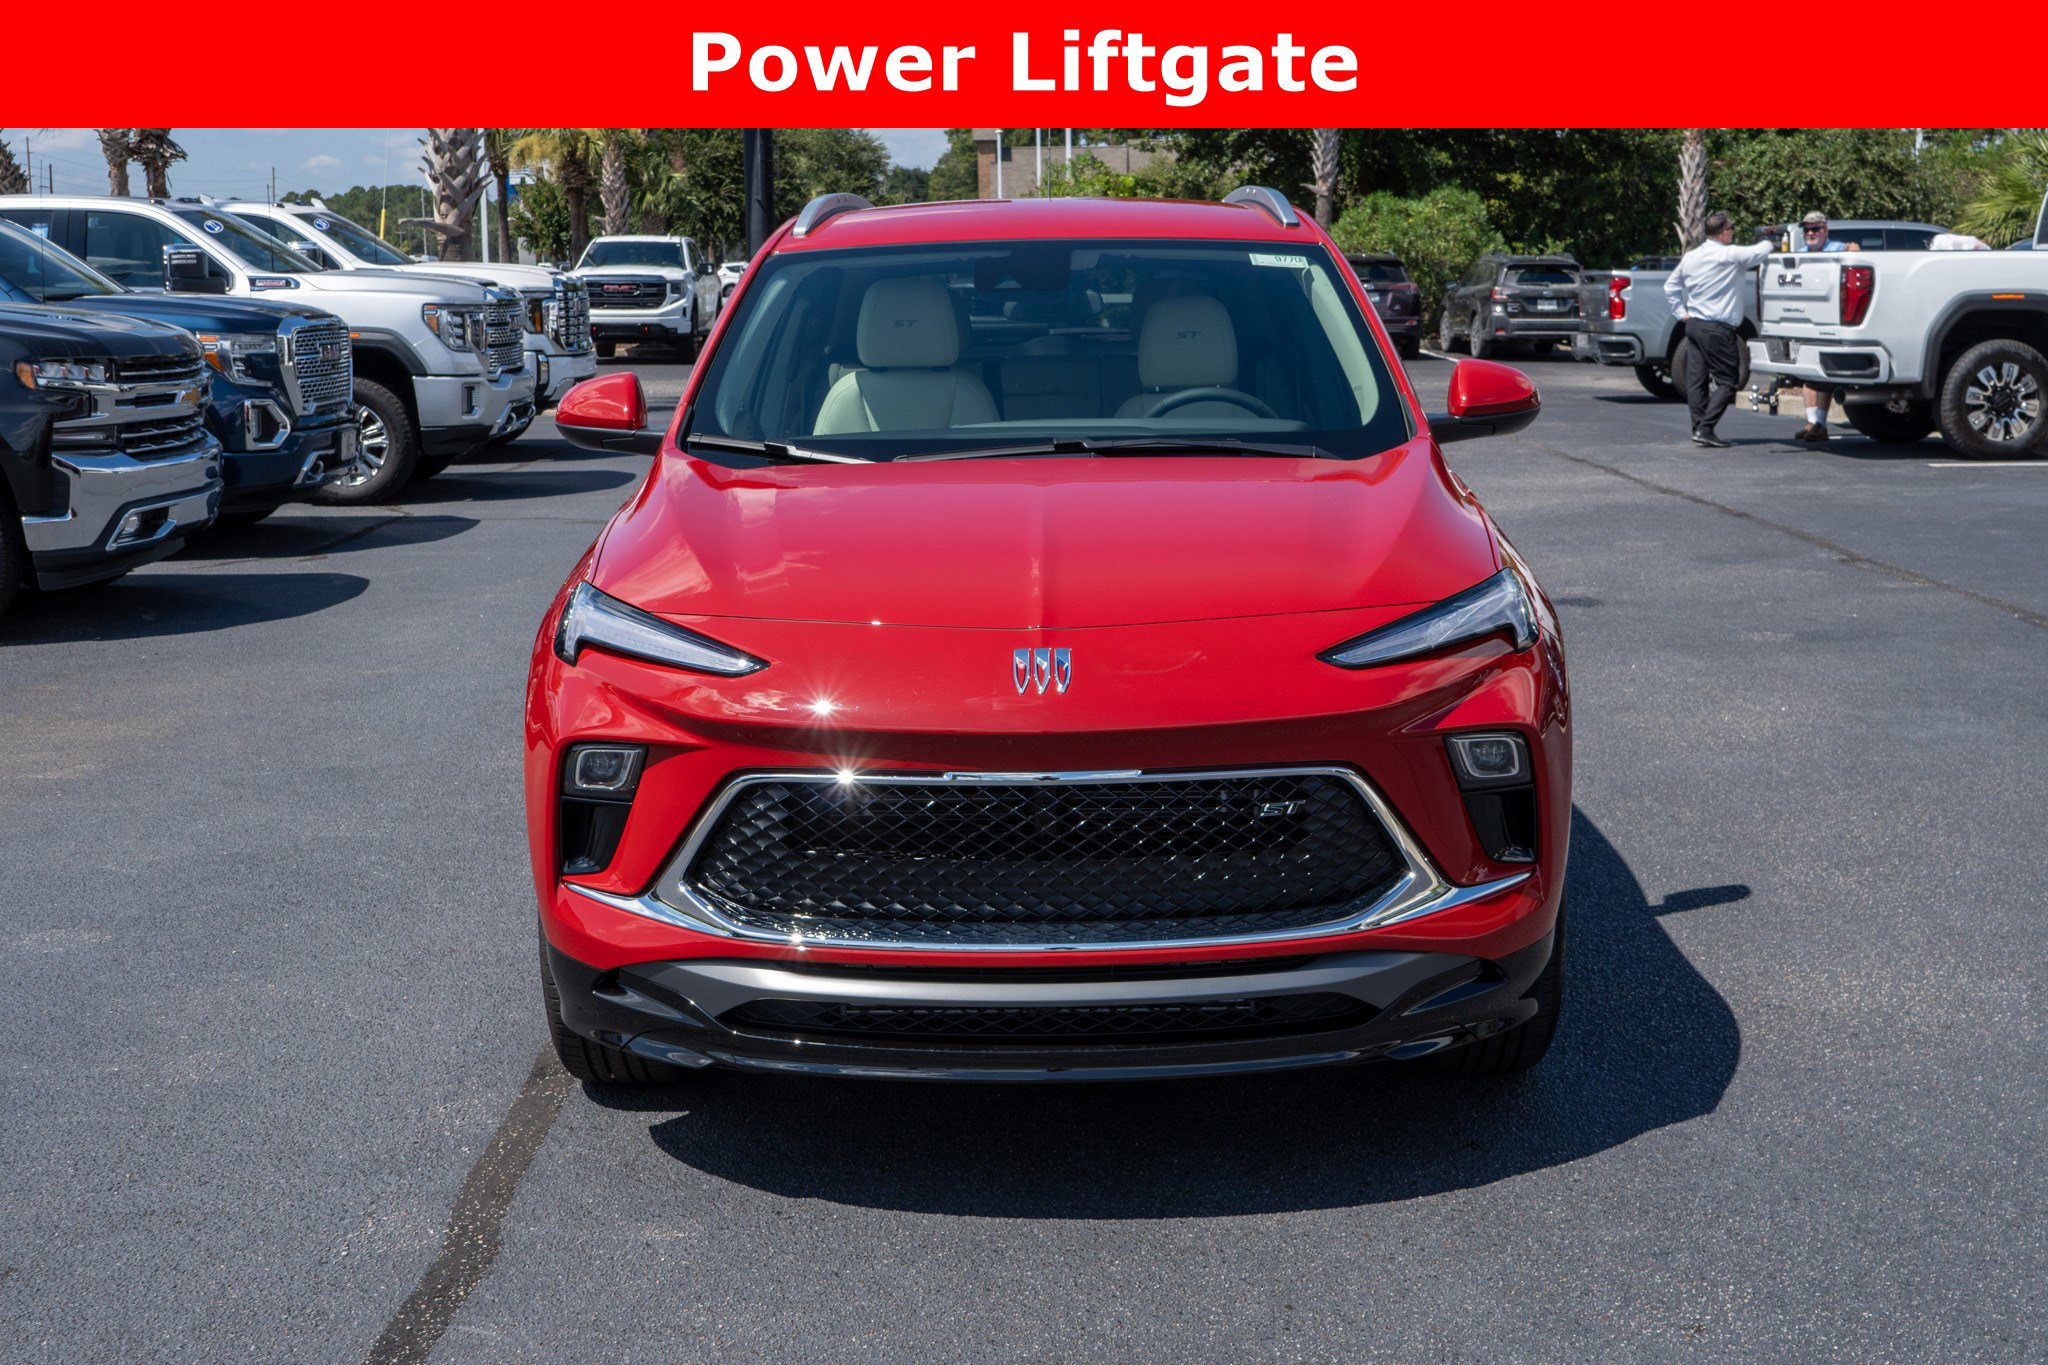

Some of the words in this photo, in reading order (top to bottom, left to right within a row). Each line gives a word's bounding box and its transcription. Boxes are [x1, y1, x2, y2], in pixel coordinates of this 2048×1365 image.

[890, 319, 919, 328] ST
[1175, 330, 1202, 339] ST
[1260, 800, 1306, 816] ST
